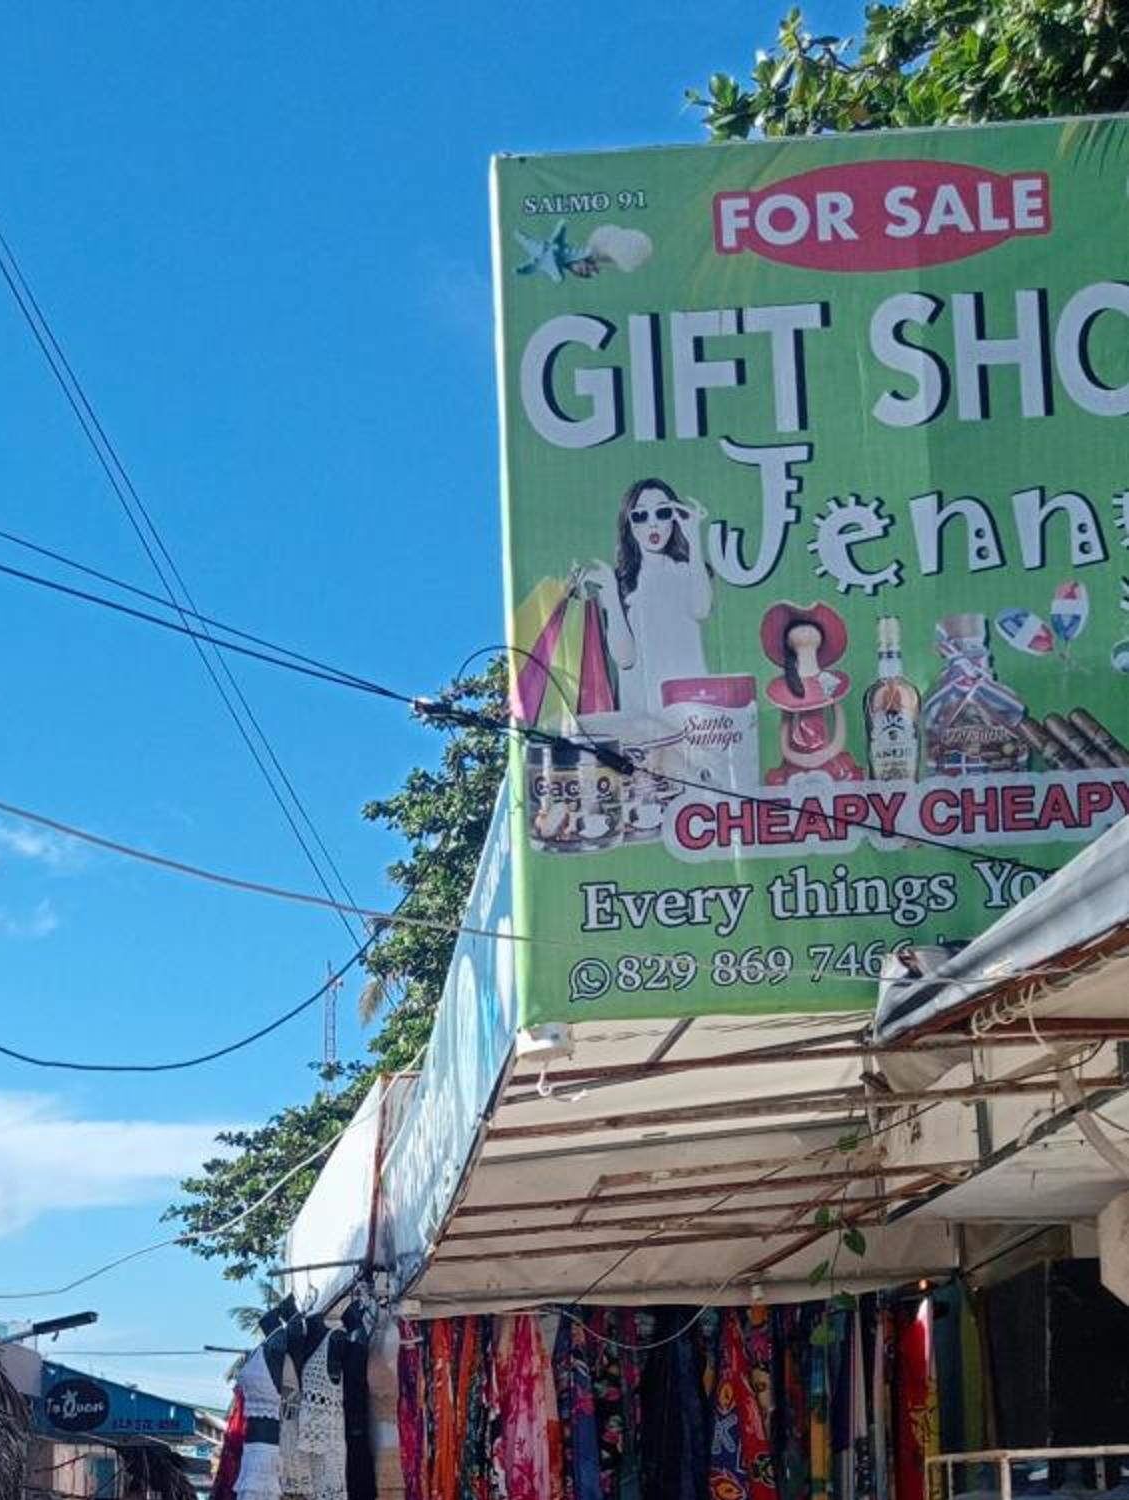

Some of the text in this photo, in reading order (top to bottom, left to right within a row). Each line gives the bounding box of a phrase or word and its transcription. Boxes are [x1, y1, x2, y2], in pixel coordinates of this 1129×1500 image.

[524, 190, 647, 215] SALMO 91
[719, 178, 1046, 249] FOR SALE
[520, 300, 831, 449] GIFT
[708, 437, 1129, 597] Jenn
[675, 791, 907, 850] CHEAPY
[581, 857, 1054, 936] Every things Yo
[615, 953, 696, 992] 829
[710, 946, 792, 986] 869
